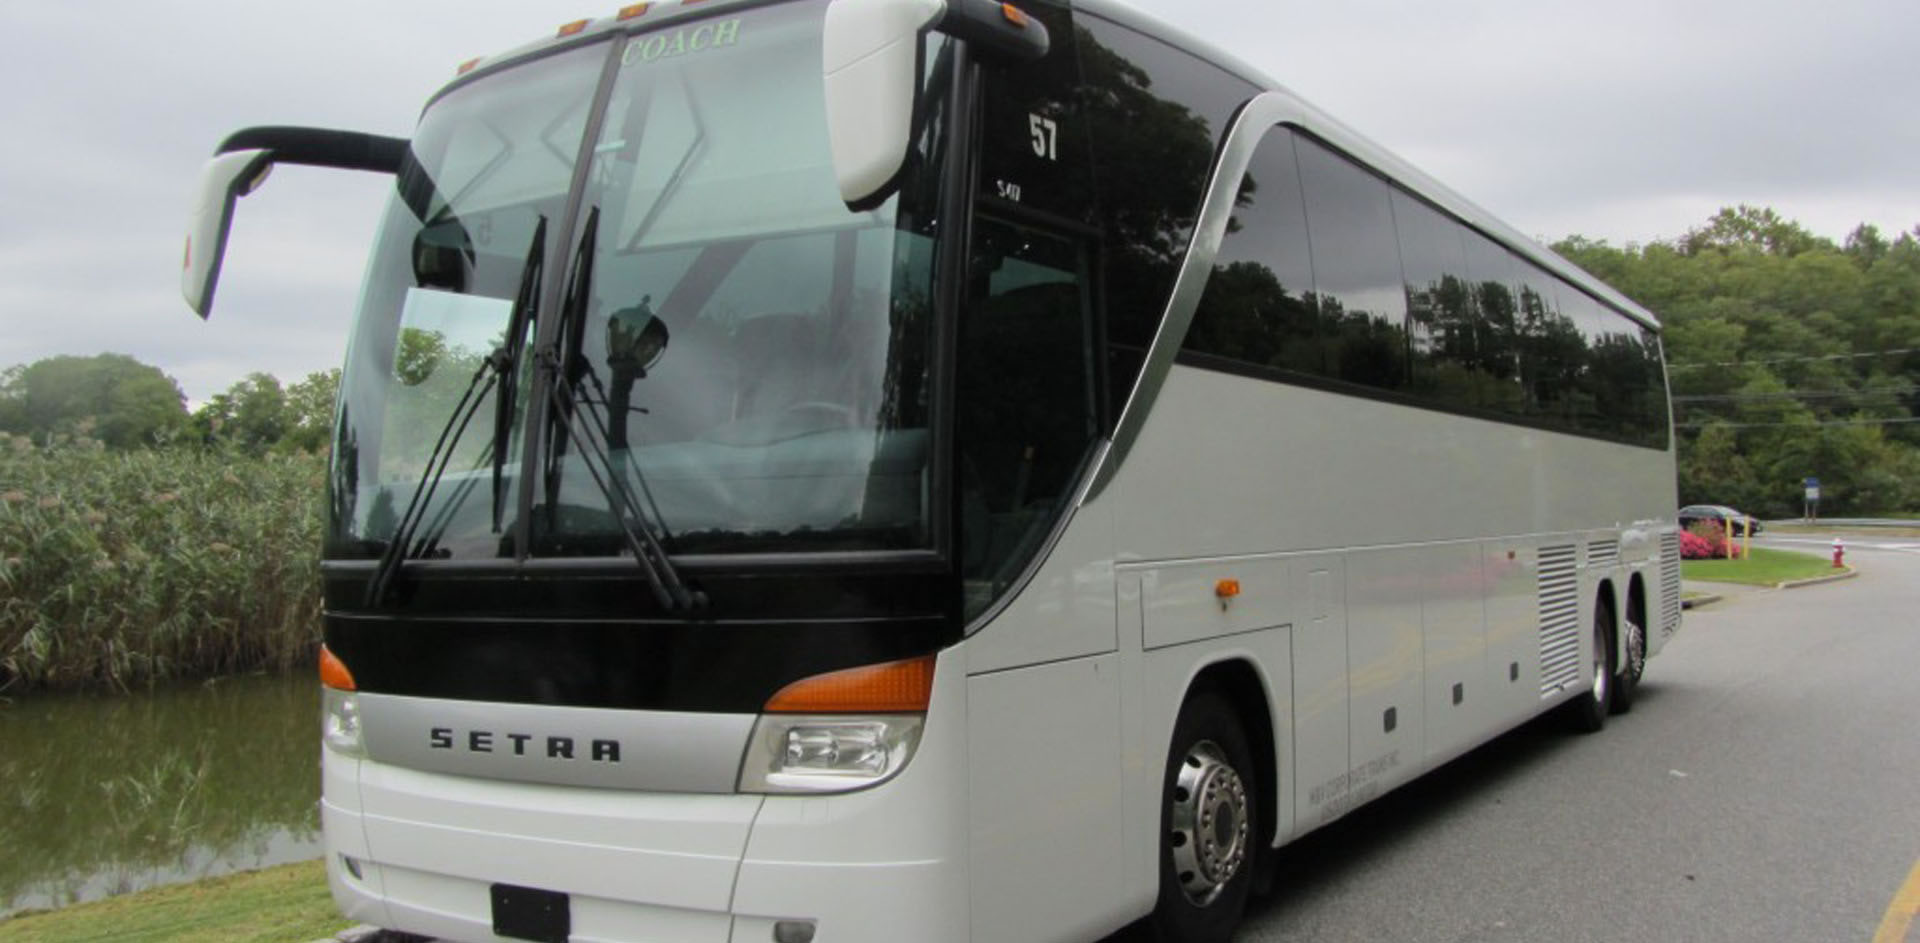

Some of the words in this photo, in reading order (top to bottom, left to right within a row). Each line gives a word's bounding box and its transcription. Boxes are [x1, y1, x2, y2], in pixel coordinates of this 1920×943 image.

[621, 18, 740, 66] COACH
[1029, 112, 1057, 161] 57
[430, 726, 621, 763] SETRA
